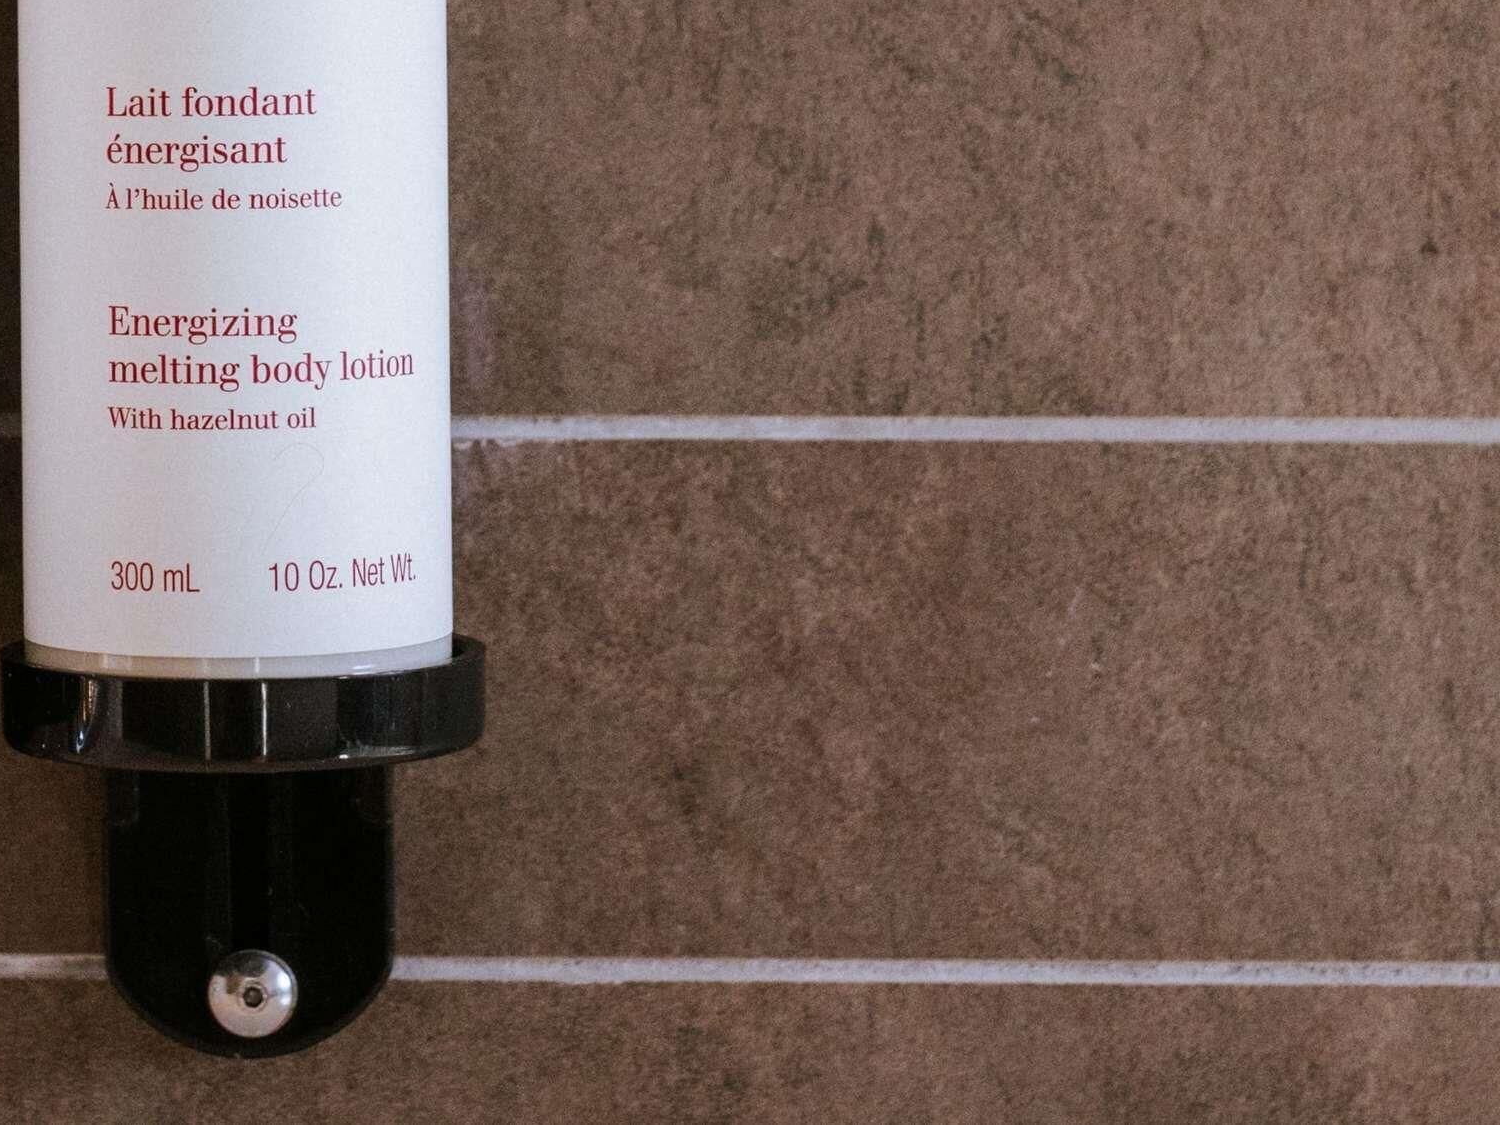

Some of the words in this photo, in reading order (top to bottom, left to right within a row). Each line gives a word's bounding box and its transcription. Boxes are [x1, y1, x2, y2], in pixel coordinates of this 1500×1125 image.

[105, 86, 173, 118] Lait
[180, 85, 318, 118] fondant
[105, 132, 288, 173] énergisant
[104, 181, 122, 210] À
[211, 187, 242, 211] de
[247, 187, 343, 211] noisette
[107, 304, 299, 346] Energizing
[108, 353, 241, 393] melting
[249, 351, 333, 391] body
[339, 348, 415, 381] lotion
[106, 405, 164, 431] With
[169, 407, 281, 433] hazelnut
[286, 406, 317, 430] oil
[110, 560, 155, 593] 300
[163, 562, 201, 593] mL
[268, 561, 300, 595] 10
[308, 559, 344, 591] Oz.
[351, 556, 386, 588] Net
[389, 552, 417, 584] Wt.
